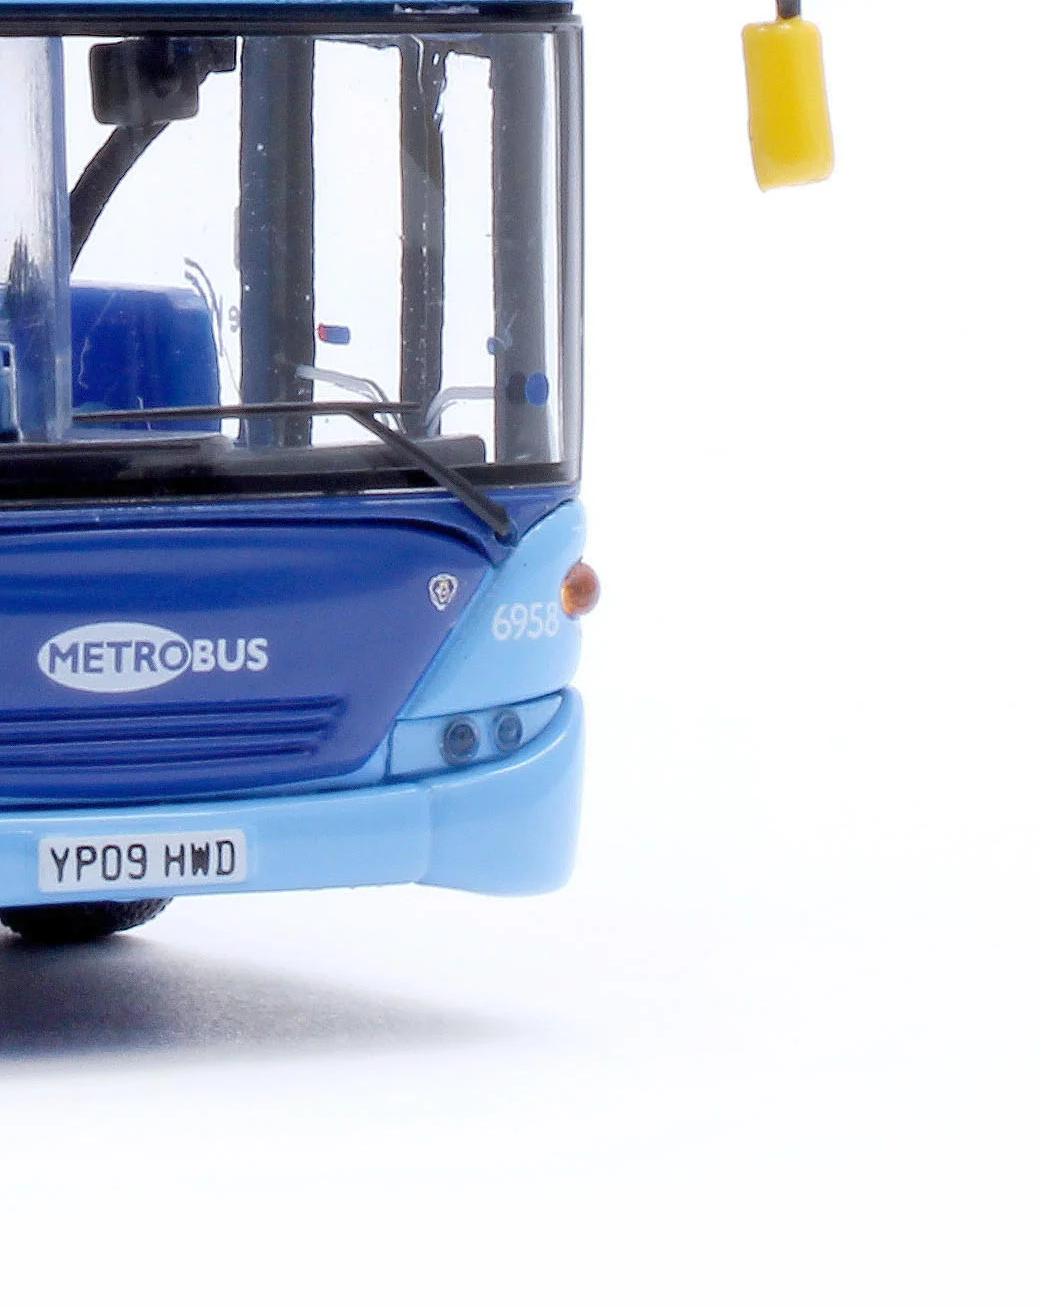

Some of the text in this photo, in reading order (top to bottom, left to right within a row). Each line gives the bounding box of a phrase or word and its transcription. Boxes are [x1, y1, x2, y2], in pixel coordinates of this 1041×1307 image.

[491, 601, 560, 641] 6958
[46, 637, 269, 675] METROBUS
[50, 840, 236, 883] YP09 HWD
